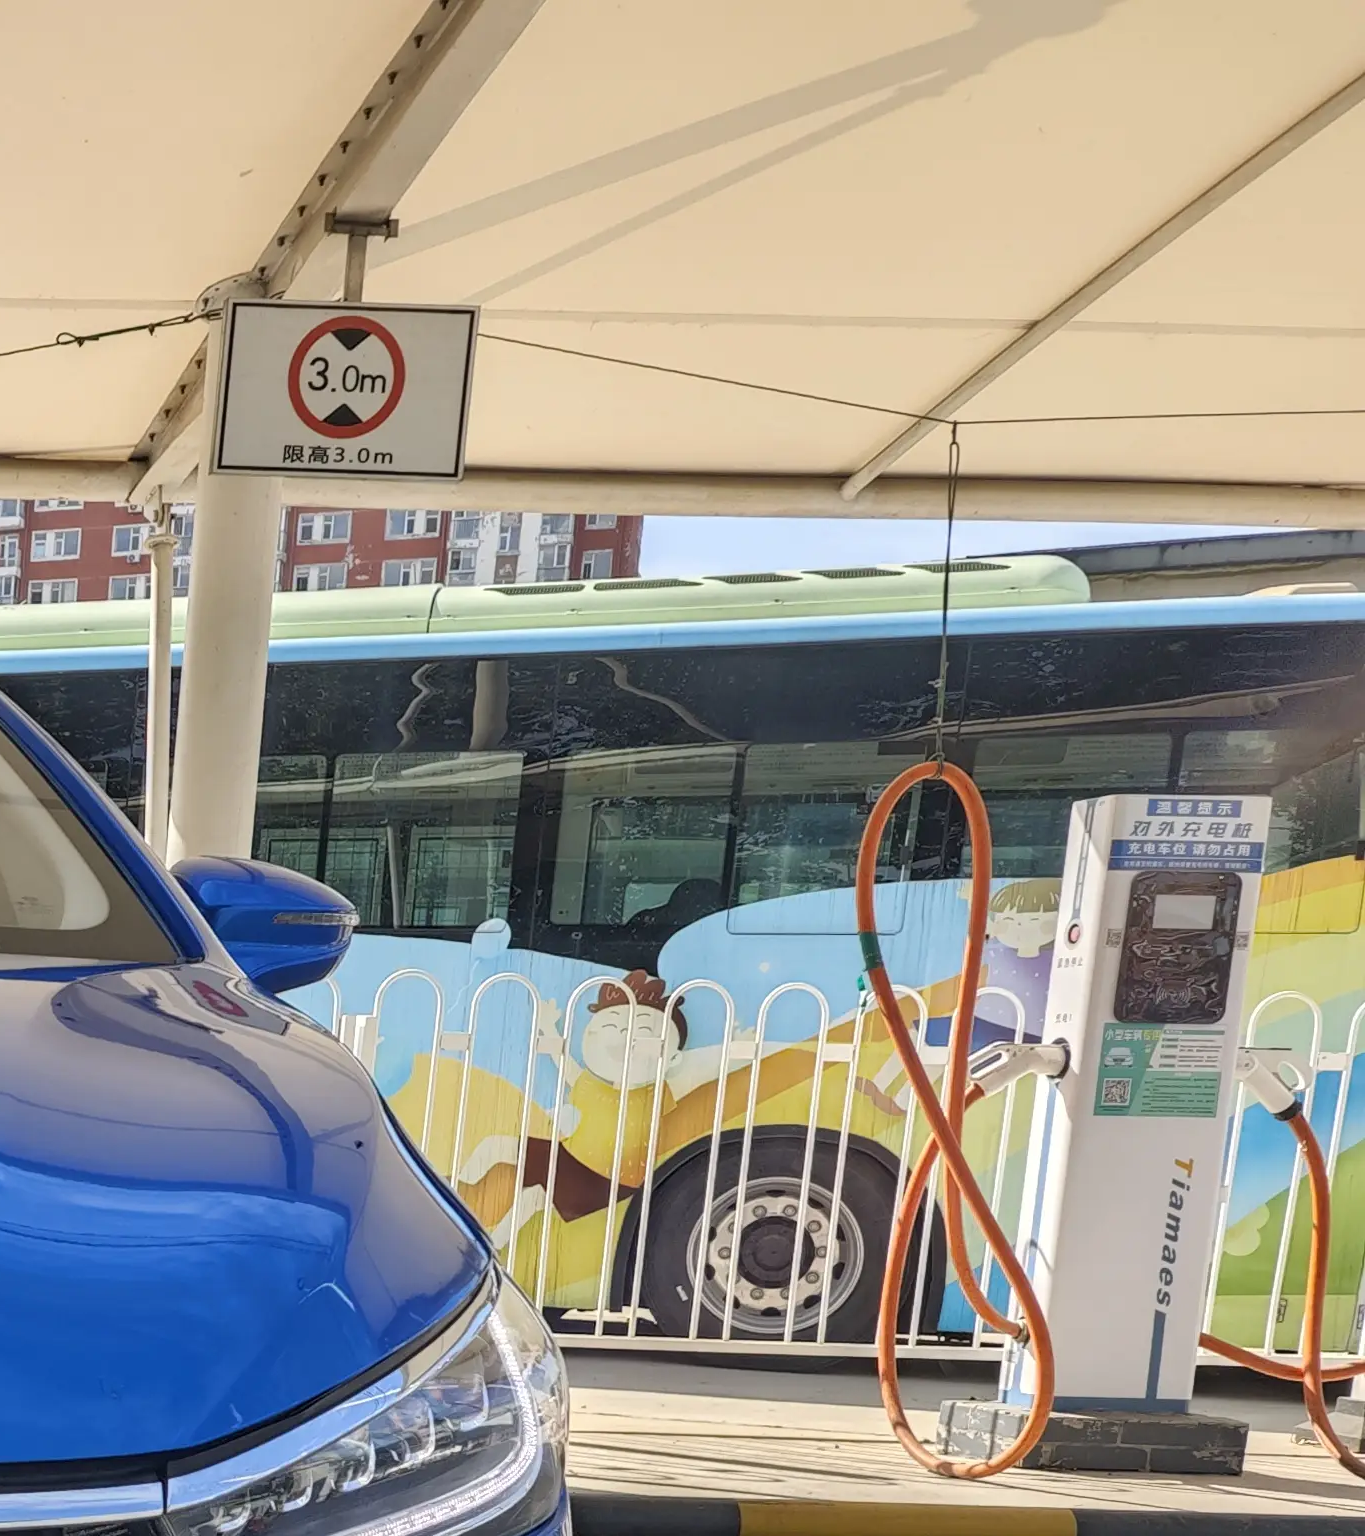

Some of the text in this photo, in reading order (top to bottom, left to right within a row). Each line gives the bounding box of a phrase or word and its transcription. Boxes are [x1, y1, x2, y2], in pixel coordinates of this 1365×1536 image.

[307, 357, 387, 394] 3.0m
[282, 445, 394, 465] 限高3.0m
[1129, 820, 1254, 838] 对外充电桩
[1127, 842, 1252, 857] 充电车位 请勿占用
[1156, 1157, 1195, 1308] Tiamaes
